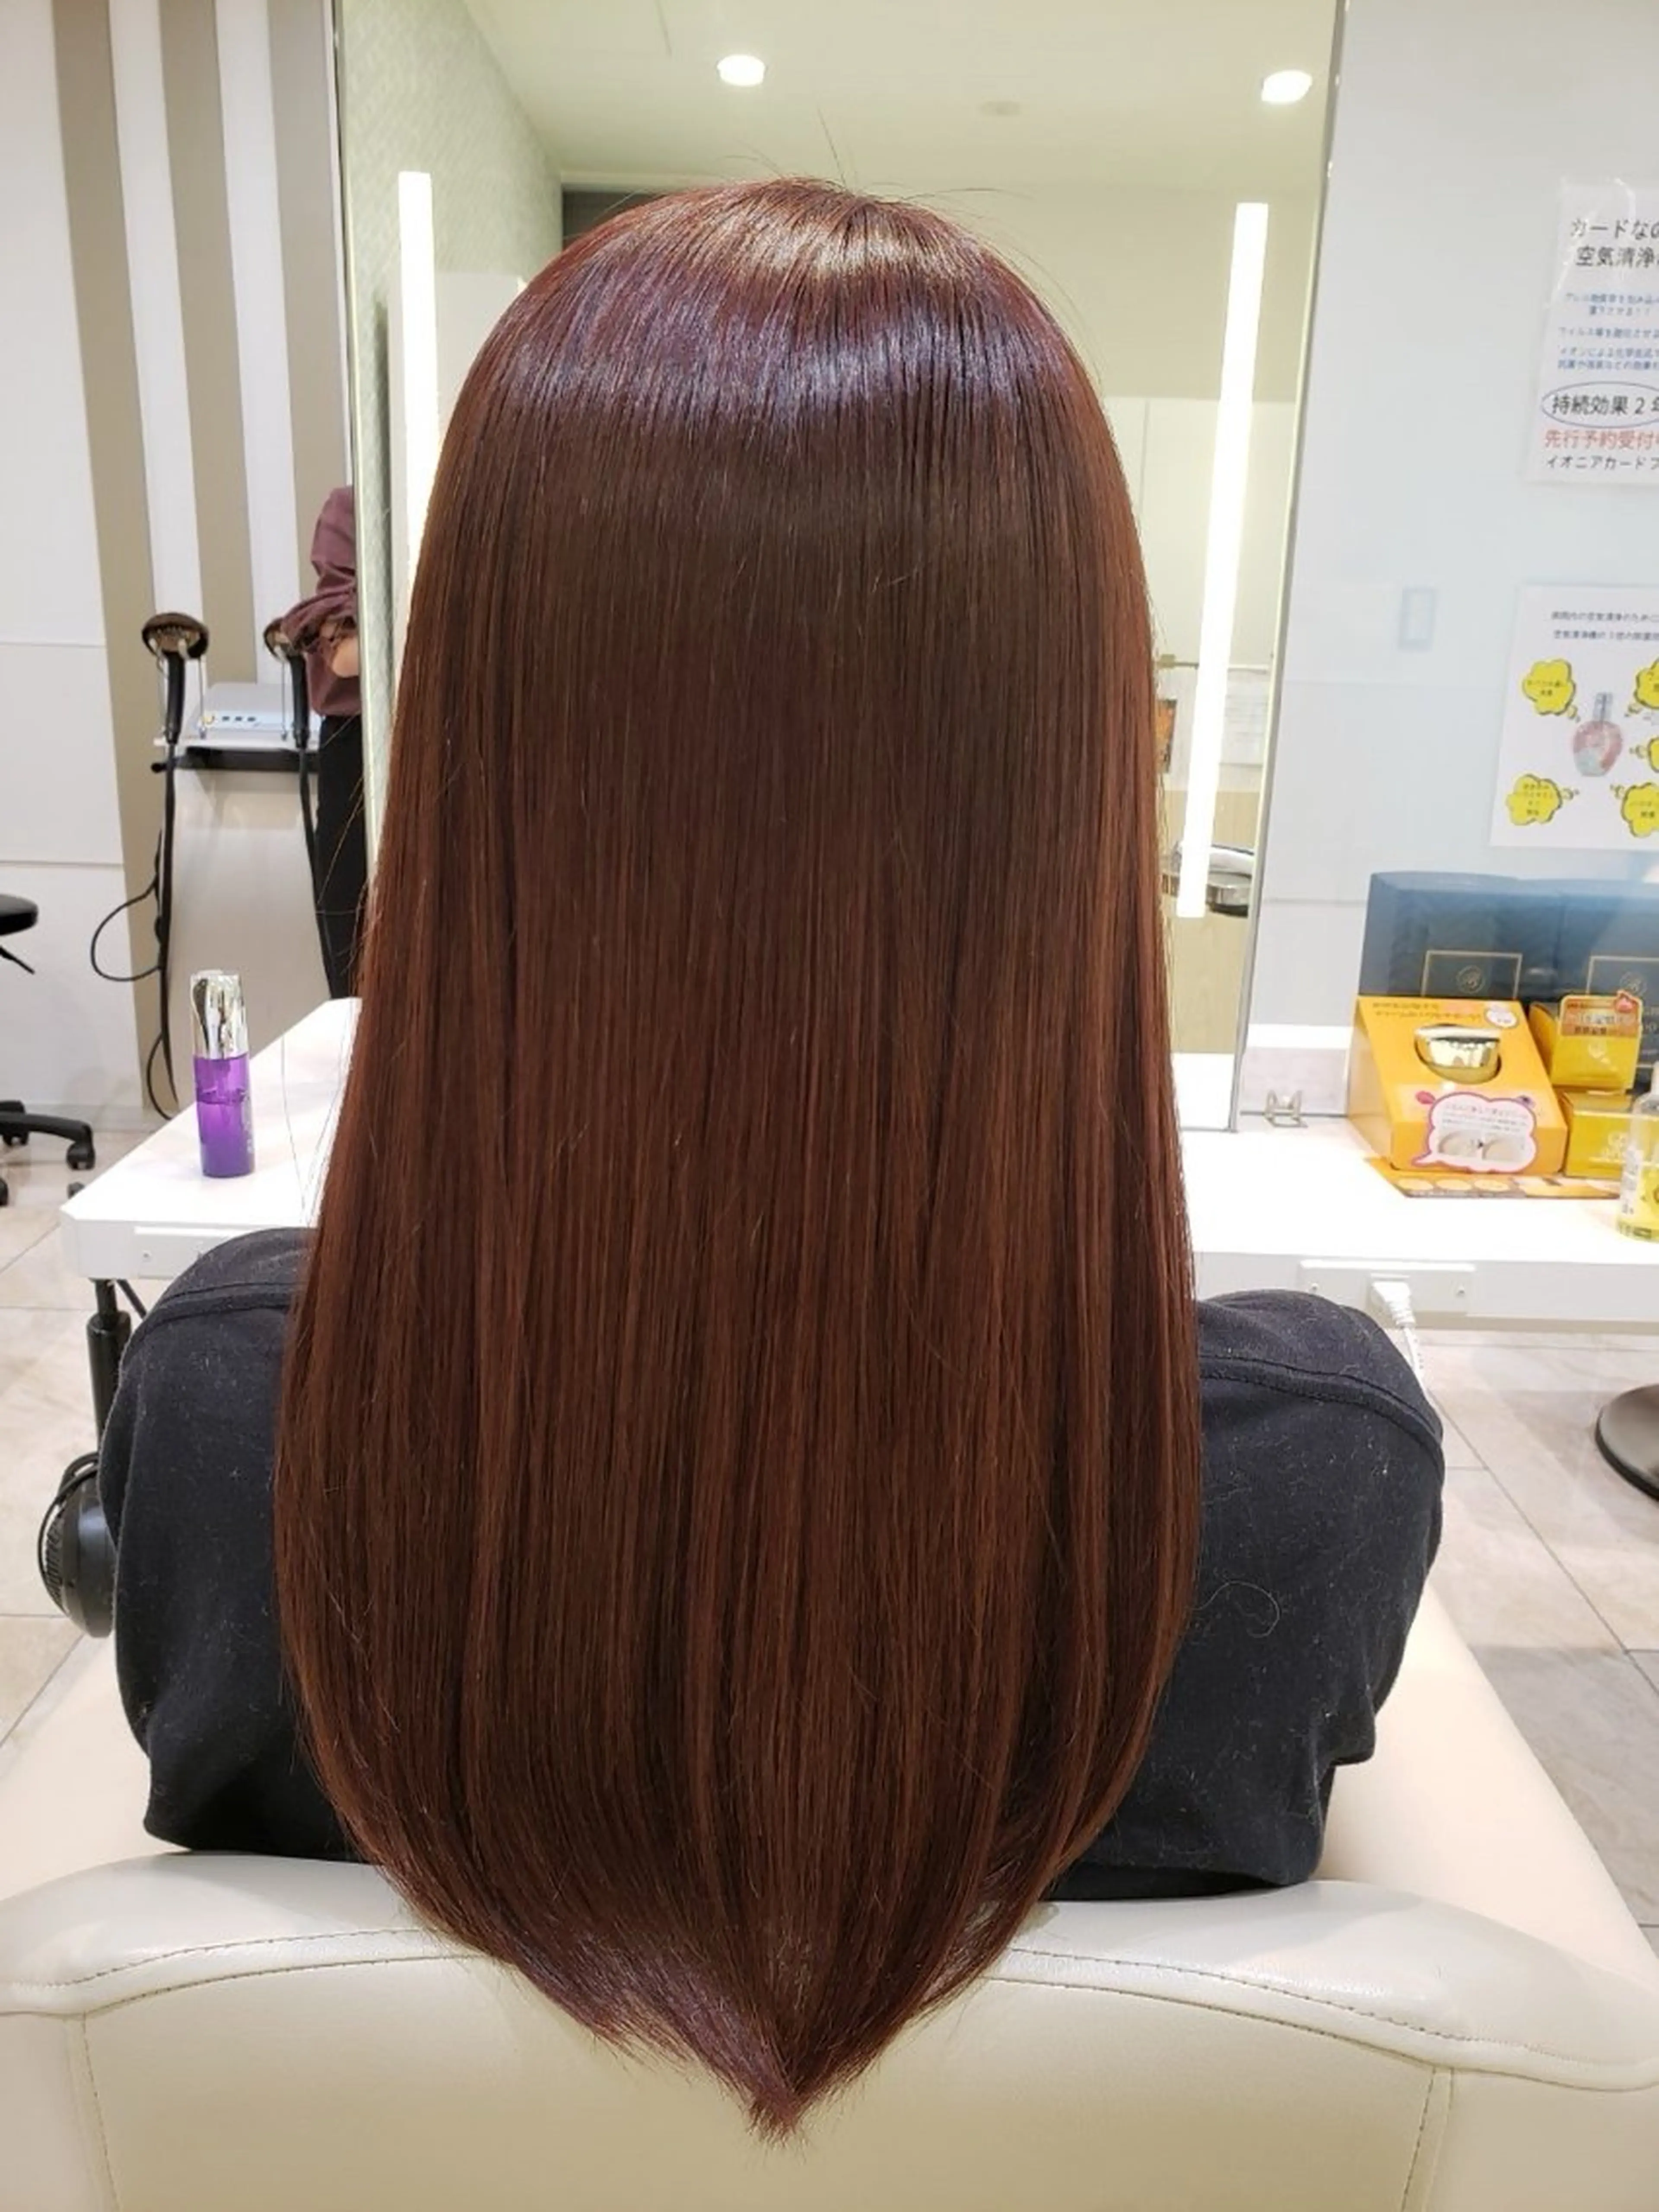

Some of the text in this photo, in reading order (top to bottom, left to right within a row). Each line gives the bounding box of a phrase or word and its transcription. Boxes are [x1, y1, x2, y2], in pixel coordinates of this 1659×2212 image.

[1576, 245, 1659, 268] 空気清浄
[1544, 429, 1659, 451] 先行予約受付
